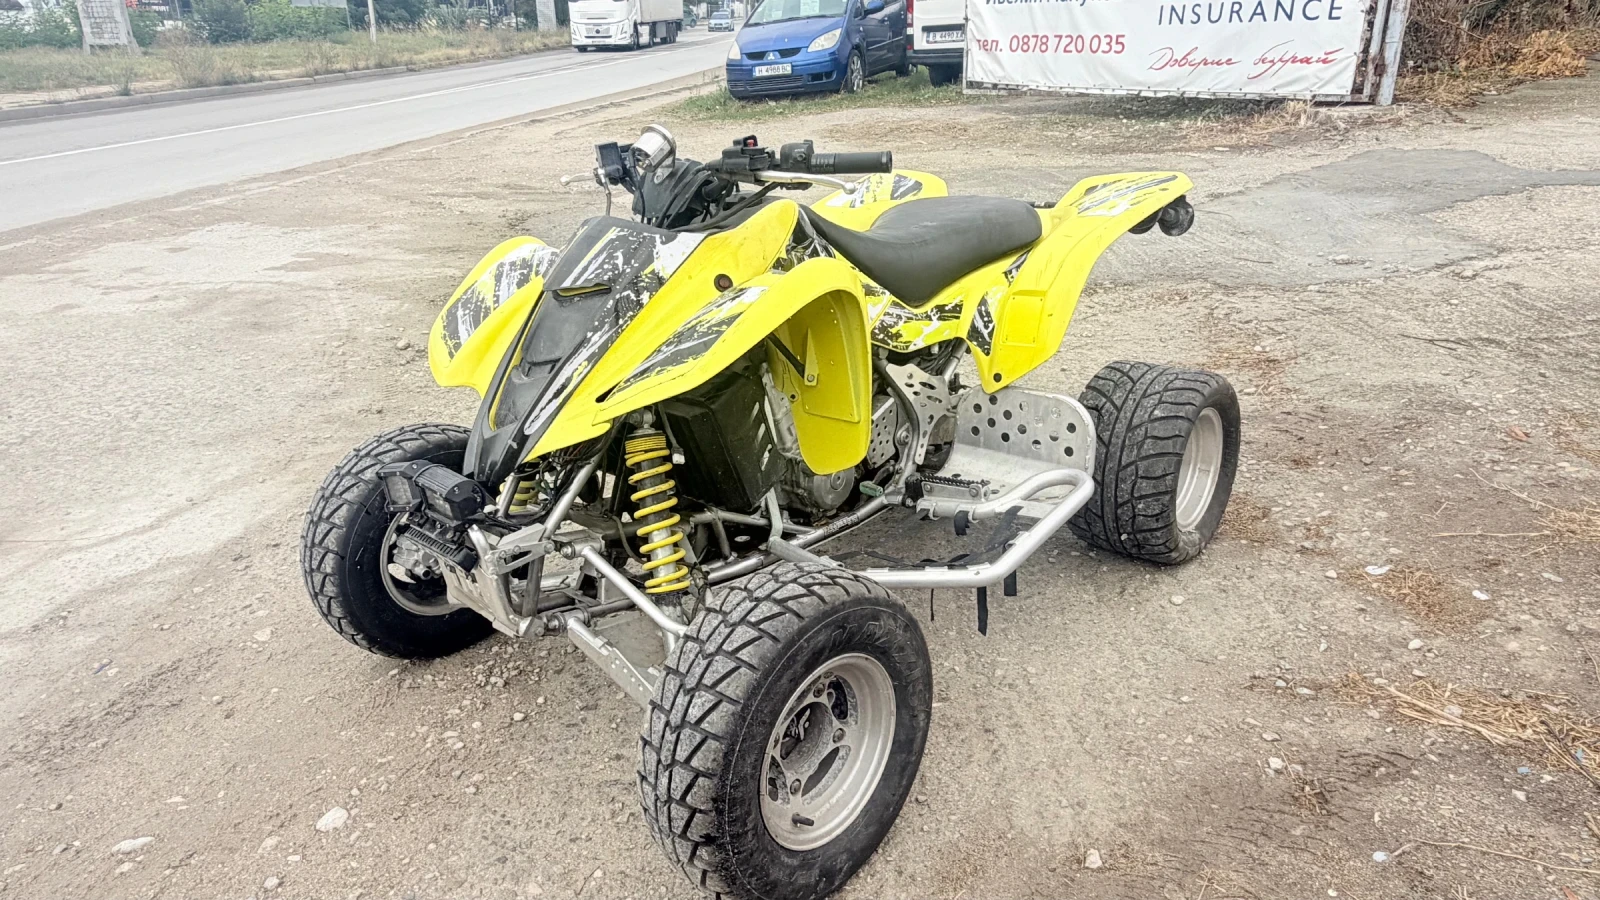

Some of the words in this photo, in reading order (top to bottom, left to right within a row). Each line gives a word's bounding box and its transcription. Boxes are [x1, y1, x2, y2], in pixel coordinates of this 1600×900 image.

[1158, 0, 1343, 25] INSURANCE
[976, 38, 1003, 52] тел.
[1009, 34, 1049, 53] 0878
[1053, 34, 1085, 54] 720
[1089, 34, 1126, 54] 035
